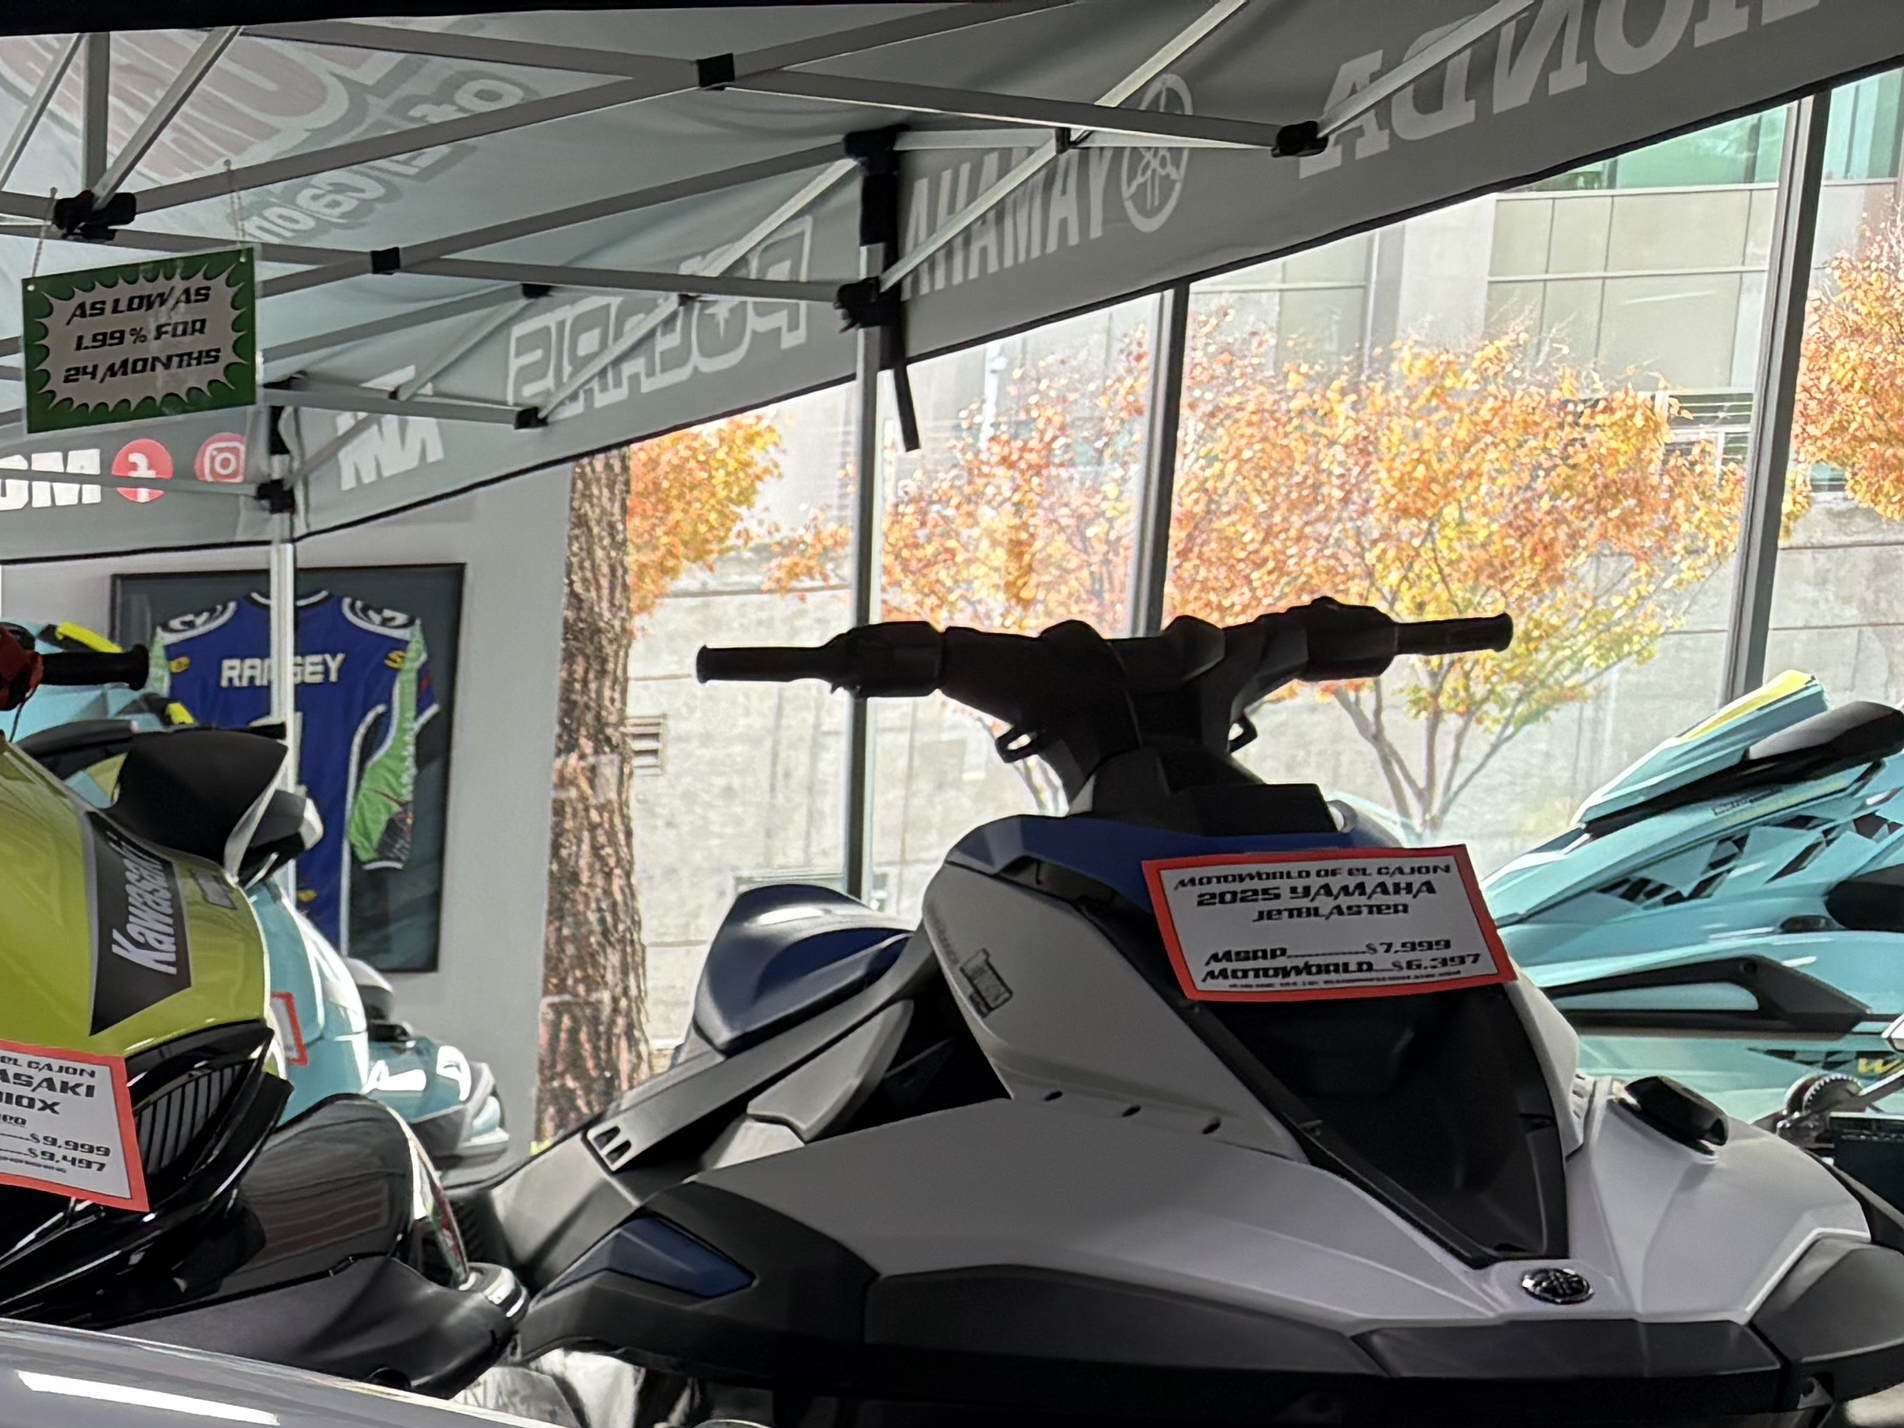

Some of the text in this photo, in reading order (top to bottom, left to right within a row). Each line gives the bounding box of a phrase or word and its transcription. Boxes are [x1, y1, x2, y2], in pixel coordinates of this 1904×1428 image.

[66, 286, 211, 326] AS LOW AS
[75, 329, 125, 352] 1.99
[153, 318, 207, 341] FOR
[63, 347, 221, 384] 24 MONTHS
[1316, 867, 1343, 878] OF
[1376, 864, 1451, 878] CAJON
[106, 831, 177, 975] Kawasaki
[1197, 880, 1438, 907] 2025 YAMAHA
[1252, 903, 1409, 922] JETBLASTER
[27, 1060, 96, 1079] CAJON
